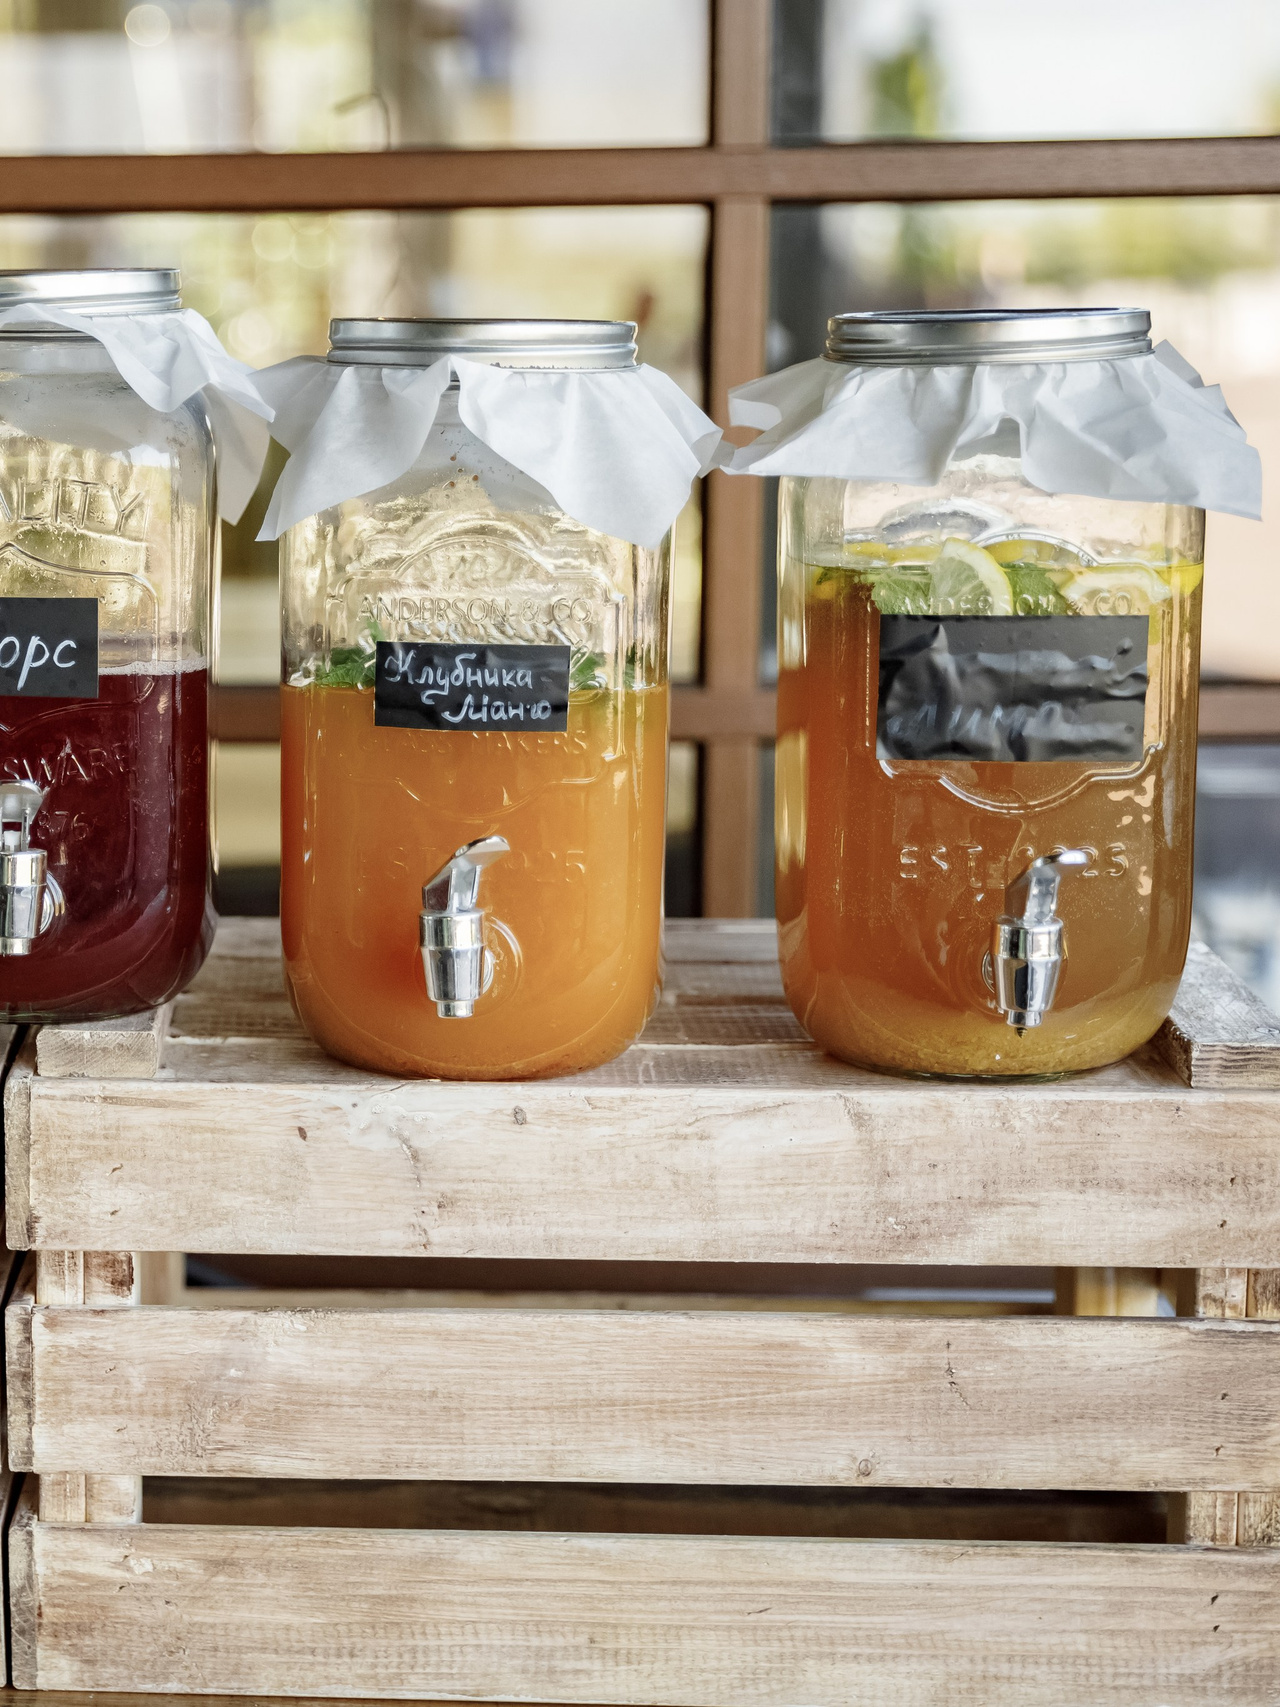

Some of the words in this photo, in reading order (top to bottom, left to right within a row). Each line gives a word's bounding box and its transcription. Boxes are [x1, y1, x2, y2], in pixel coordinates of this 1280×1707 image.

[356, 597, 509, 624] ANDERSON
[520, 598, 543, 625] &
[35, 812, 90, 842] 876
